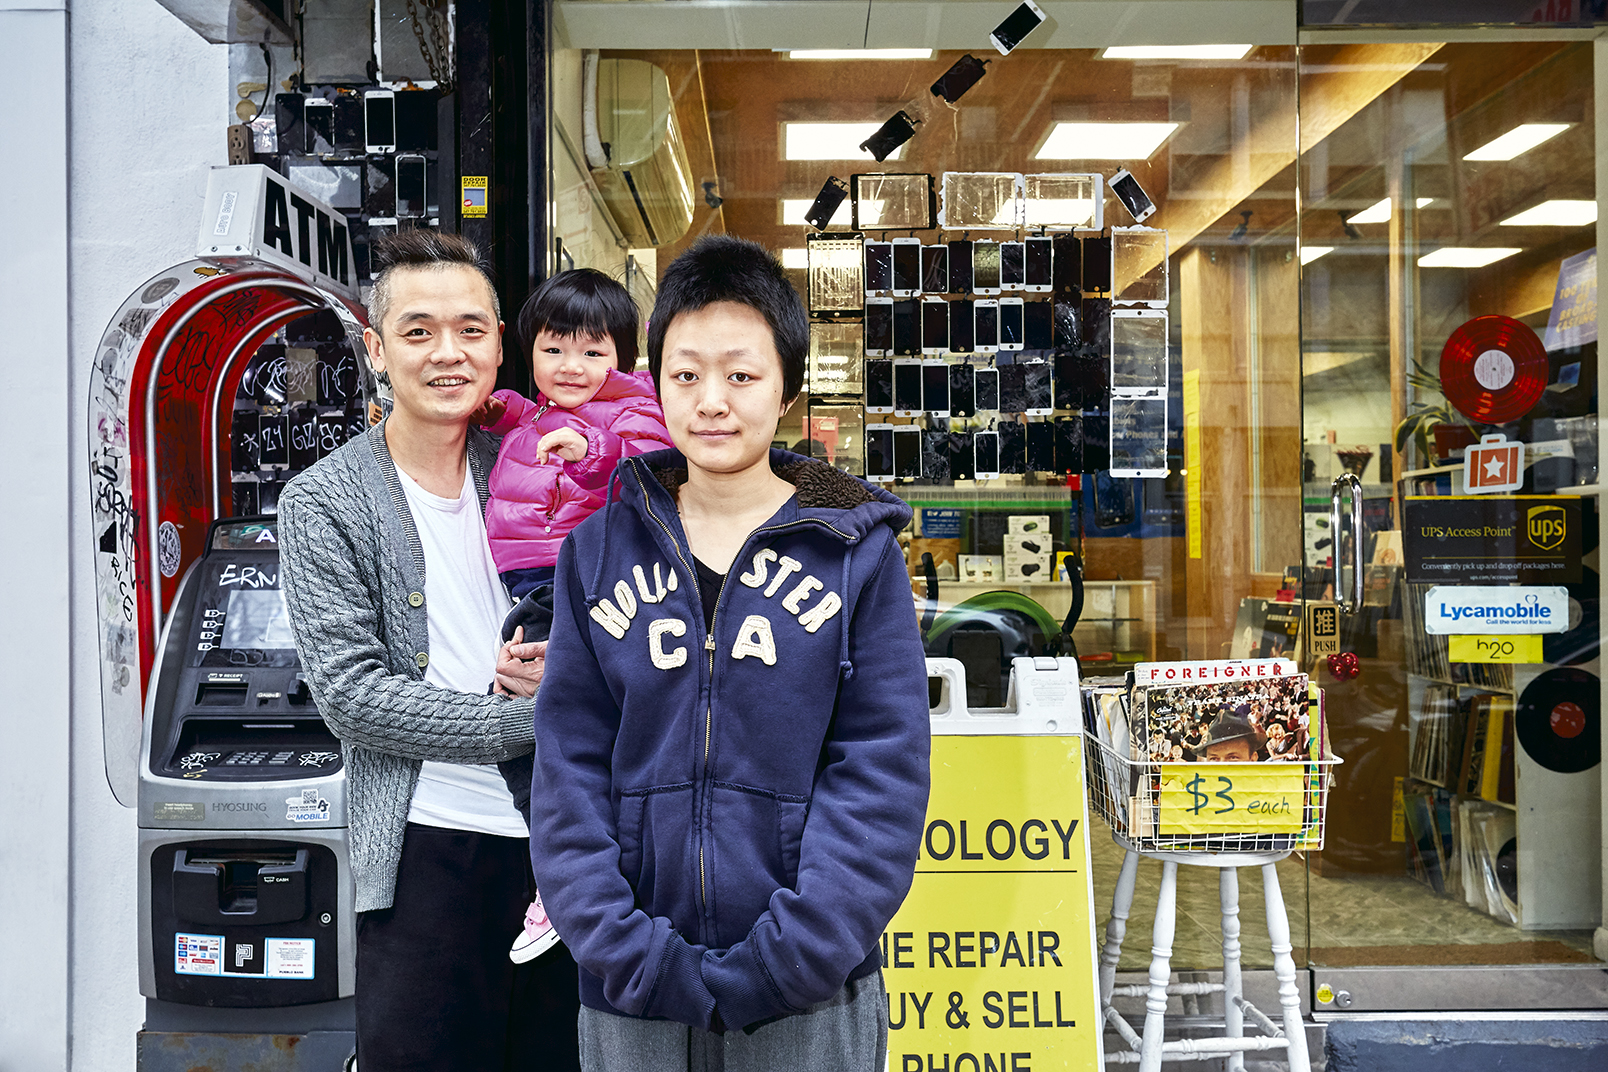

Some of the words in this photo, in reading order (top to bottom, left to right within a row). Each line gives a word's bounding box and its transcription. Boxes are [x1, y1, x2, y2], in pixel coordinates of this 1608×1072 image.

[264, 177, 349, 286] ATM
[1421, 526, 1443, 537] UPS
[1446, 526, 1482, 537] Access
[1530, 519, 1563, 543] ups
[1421, 562, 1462, 571] Conveniently
[1462, 562, 1476, 571] pick
[1485, 562, 1498, 570] and
[1522, 562, 1550, 571] packages
[1440, 603, 1551, 620] Lycamobile
[1314, 609, 1335, 635] 推
[1314, 640, 1337, 652] PUSH
[1151, 663, 1283, 680] FOREIGNER
[1185, 772, 1235, 816] $3
[1247, 796, 1291, 815] each
[212, 802, 267, 812] HYOSUNG
[295, 812, 329, 820] MOBILE
[917, 818, 1080, 861] OLOGY
[928, 931, 1064, 969] REPAIR
[945, 991, 971, 1030] &
[982, 990, 1077, 1029] SELL
